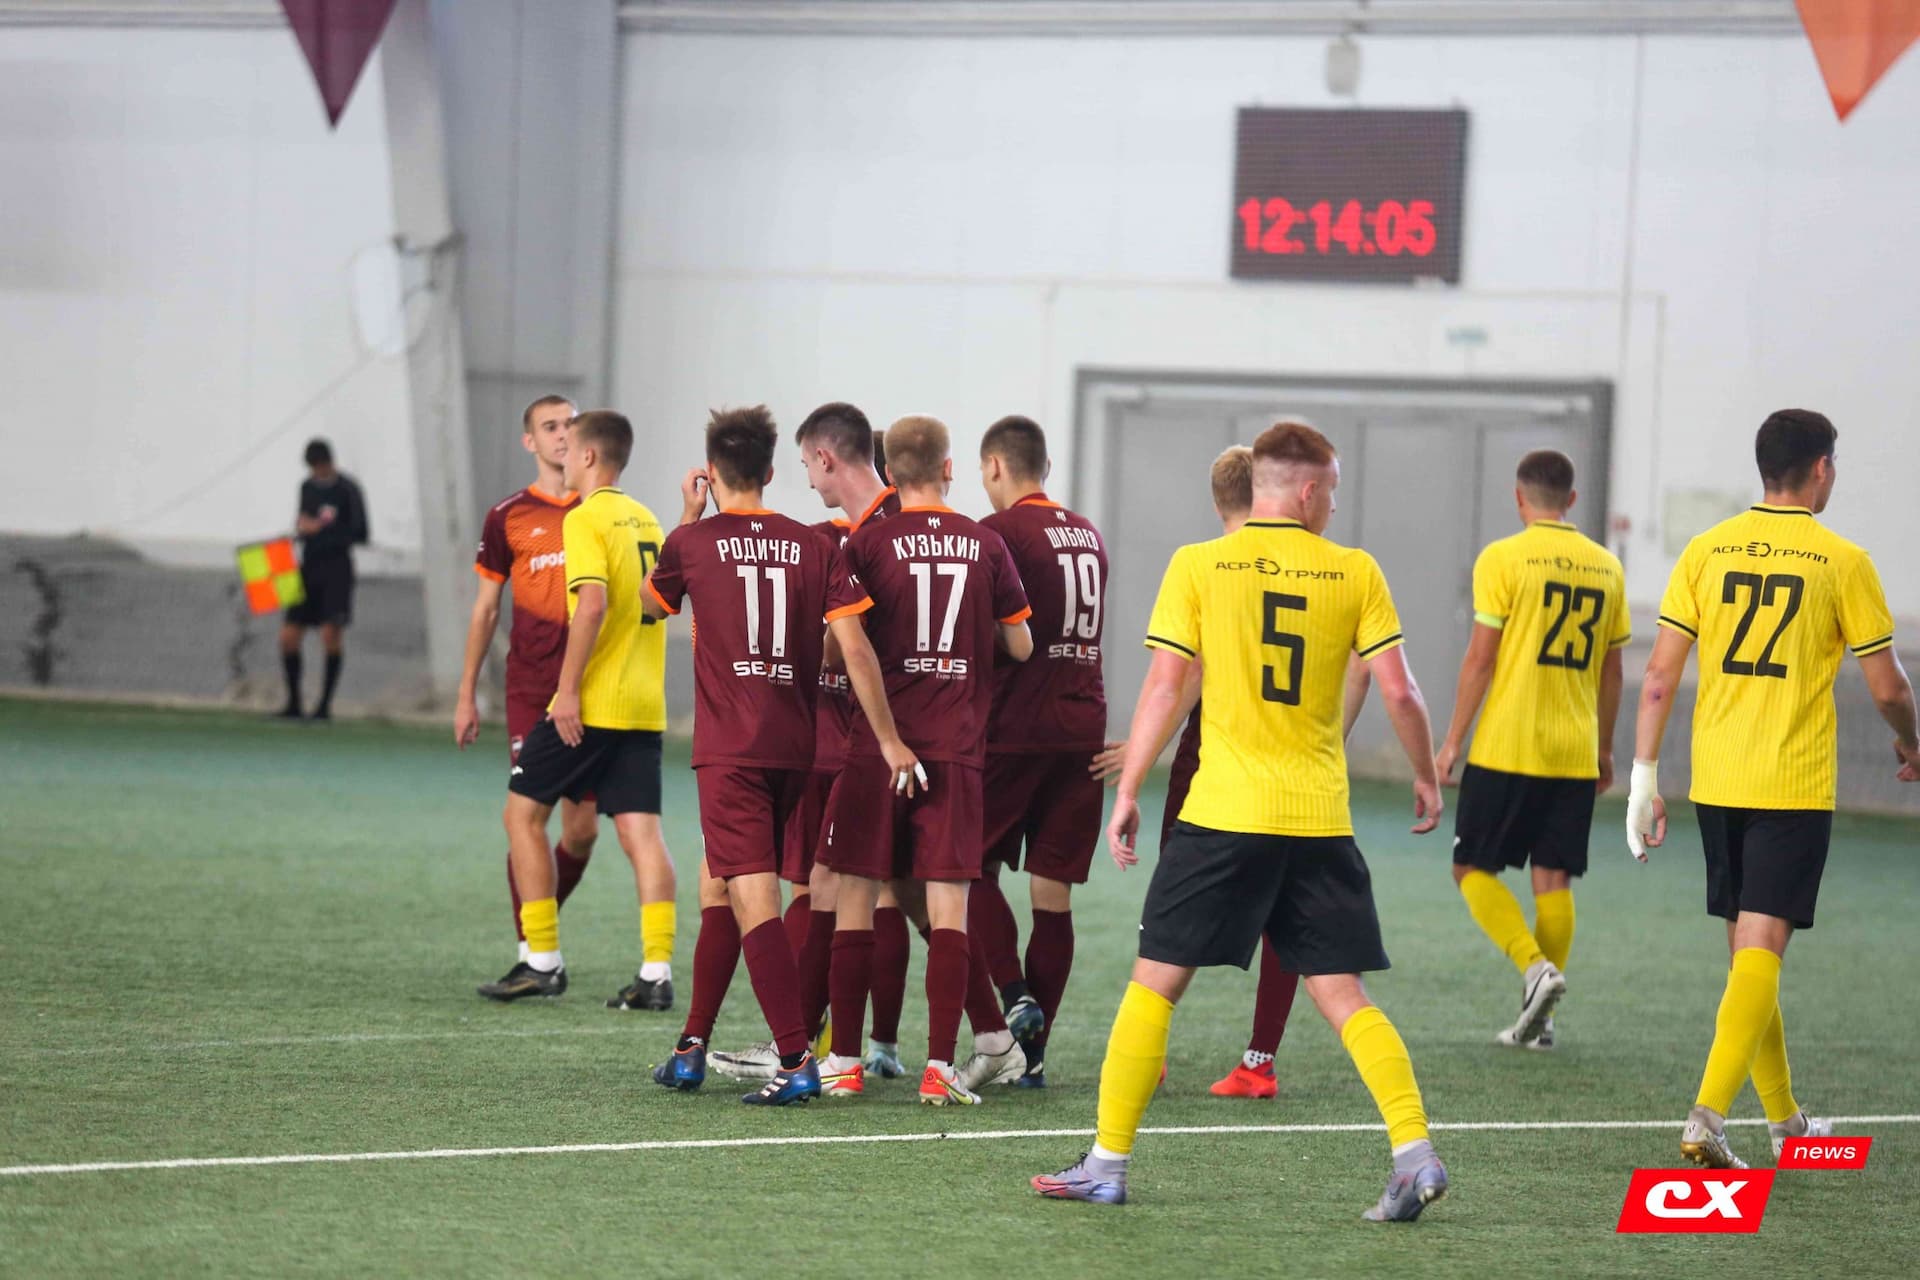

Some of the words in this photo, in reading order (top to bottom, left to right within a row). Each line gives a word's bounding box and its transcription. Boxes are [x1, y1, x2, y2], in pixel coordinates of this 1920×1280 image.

[1237, 196, 1437, 257] 12:14:05
[715, 537, 801, 565] РОДИЧЕВ
[892, 534, 981, 562] КУЗЬКИН
[1044, 527, 1100, 552] ШИБАЕВ
[1215, 561, 1252, 571] АСР
[736, 565, 787, 658] 11
[909, 562, 968, 652] 17
[1057, 553, 1101, 640] 19
[1537, 581, 1605, 672] 23
[1722, 571, 1805, 680] 22
[903, 657, 968, 674] SEUS
[1048, 643, 1099, 660] SEUS
[1261, 590, 1308, 707] 5
